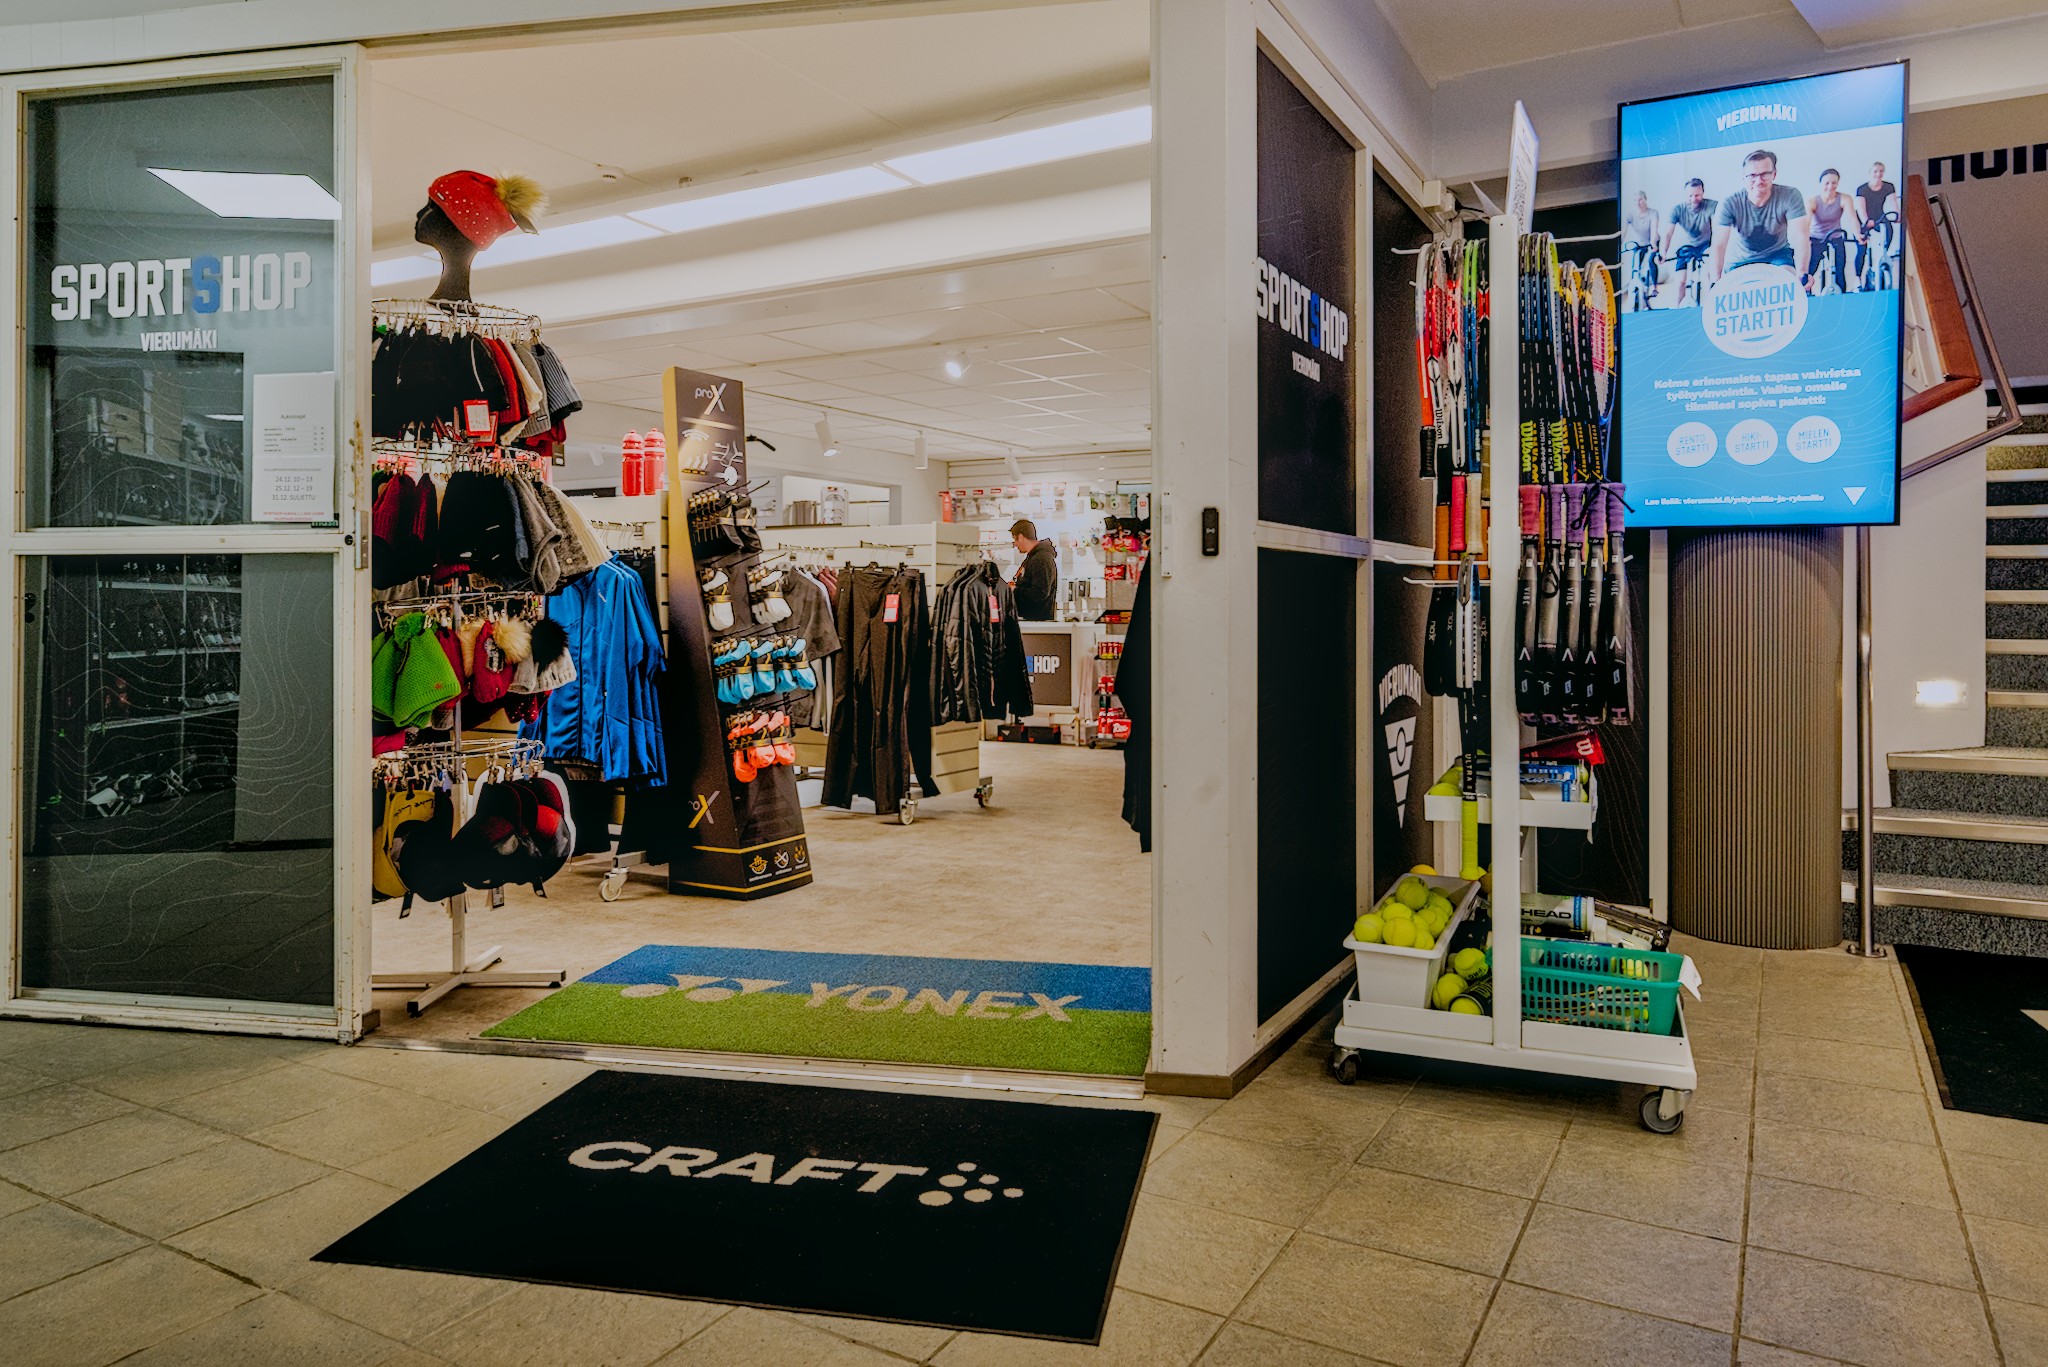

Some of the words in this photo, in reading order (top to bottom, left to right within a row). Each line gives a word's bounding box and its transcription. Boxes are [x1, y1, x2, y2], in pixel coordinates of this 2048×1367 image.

[51, 251, 312, 321] SPORTSHOP
[1715, 282, 1795, 314] KUNNON
[1257, 256, 1349, 362] SPORTSHOP
[1716, 305, 1794, 337] STARTTI
[140, 329, 218, 352] VIERUMÄKI
[1654, 379, 1690, 390] Kolme
[1692, 373, 1762, 387] erinomaista
[1764, 372, 1799, 383] tapaa
[1801, 367, 1862, 380] vahvistaa
[1761, 383, 1802, 395] Valitse
[1805, 380, 1848, 392] omalle
[1738, 397, 1777, 410] sopiva
[1435, 408, 1444, 439] Wilson
[1798, 428, 1830, 440] MIELEN
[1520, 420, 1534, 473] Wilson
[1550, 420, 1563, 472] Wilson
[1676, 443, 1709, 456] STARTTI
[1734, 440, 1769, 453] STARTTI
[1795, 438, 1832, 451] STARTTI
[1464, 753, 1473, 782] ULTRA
[1521, 908, 1572, 919] HEAD
[802, 981, 1082, 1022] YONEX
[567, 1140, 929, 1193] CRAFT
